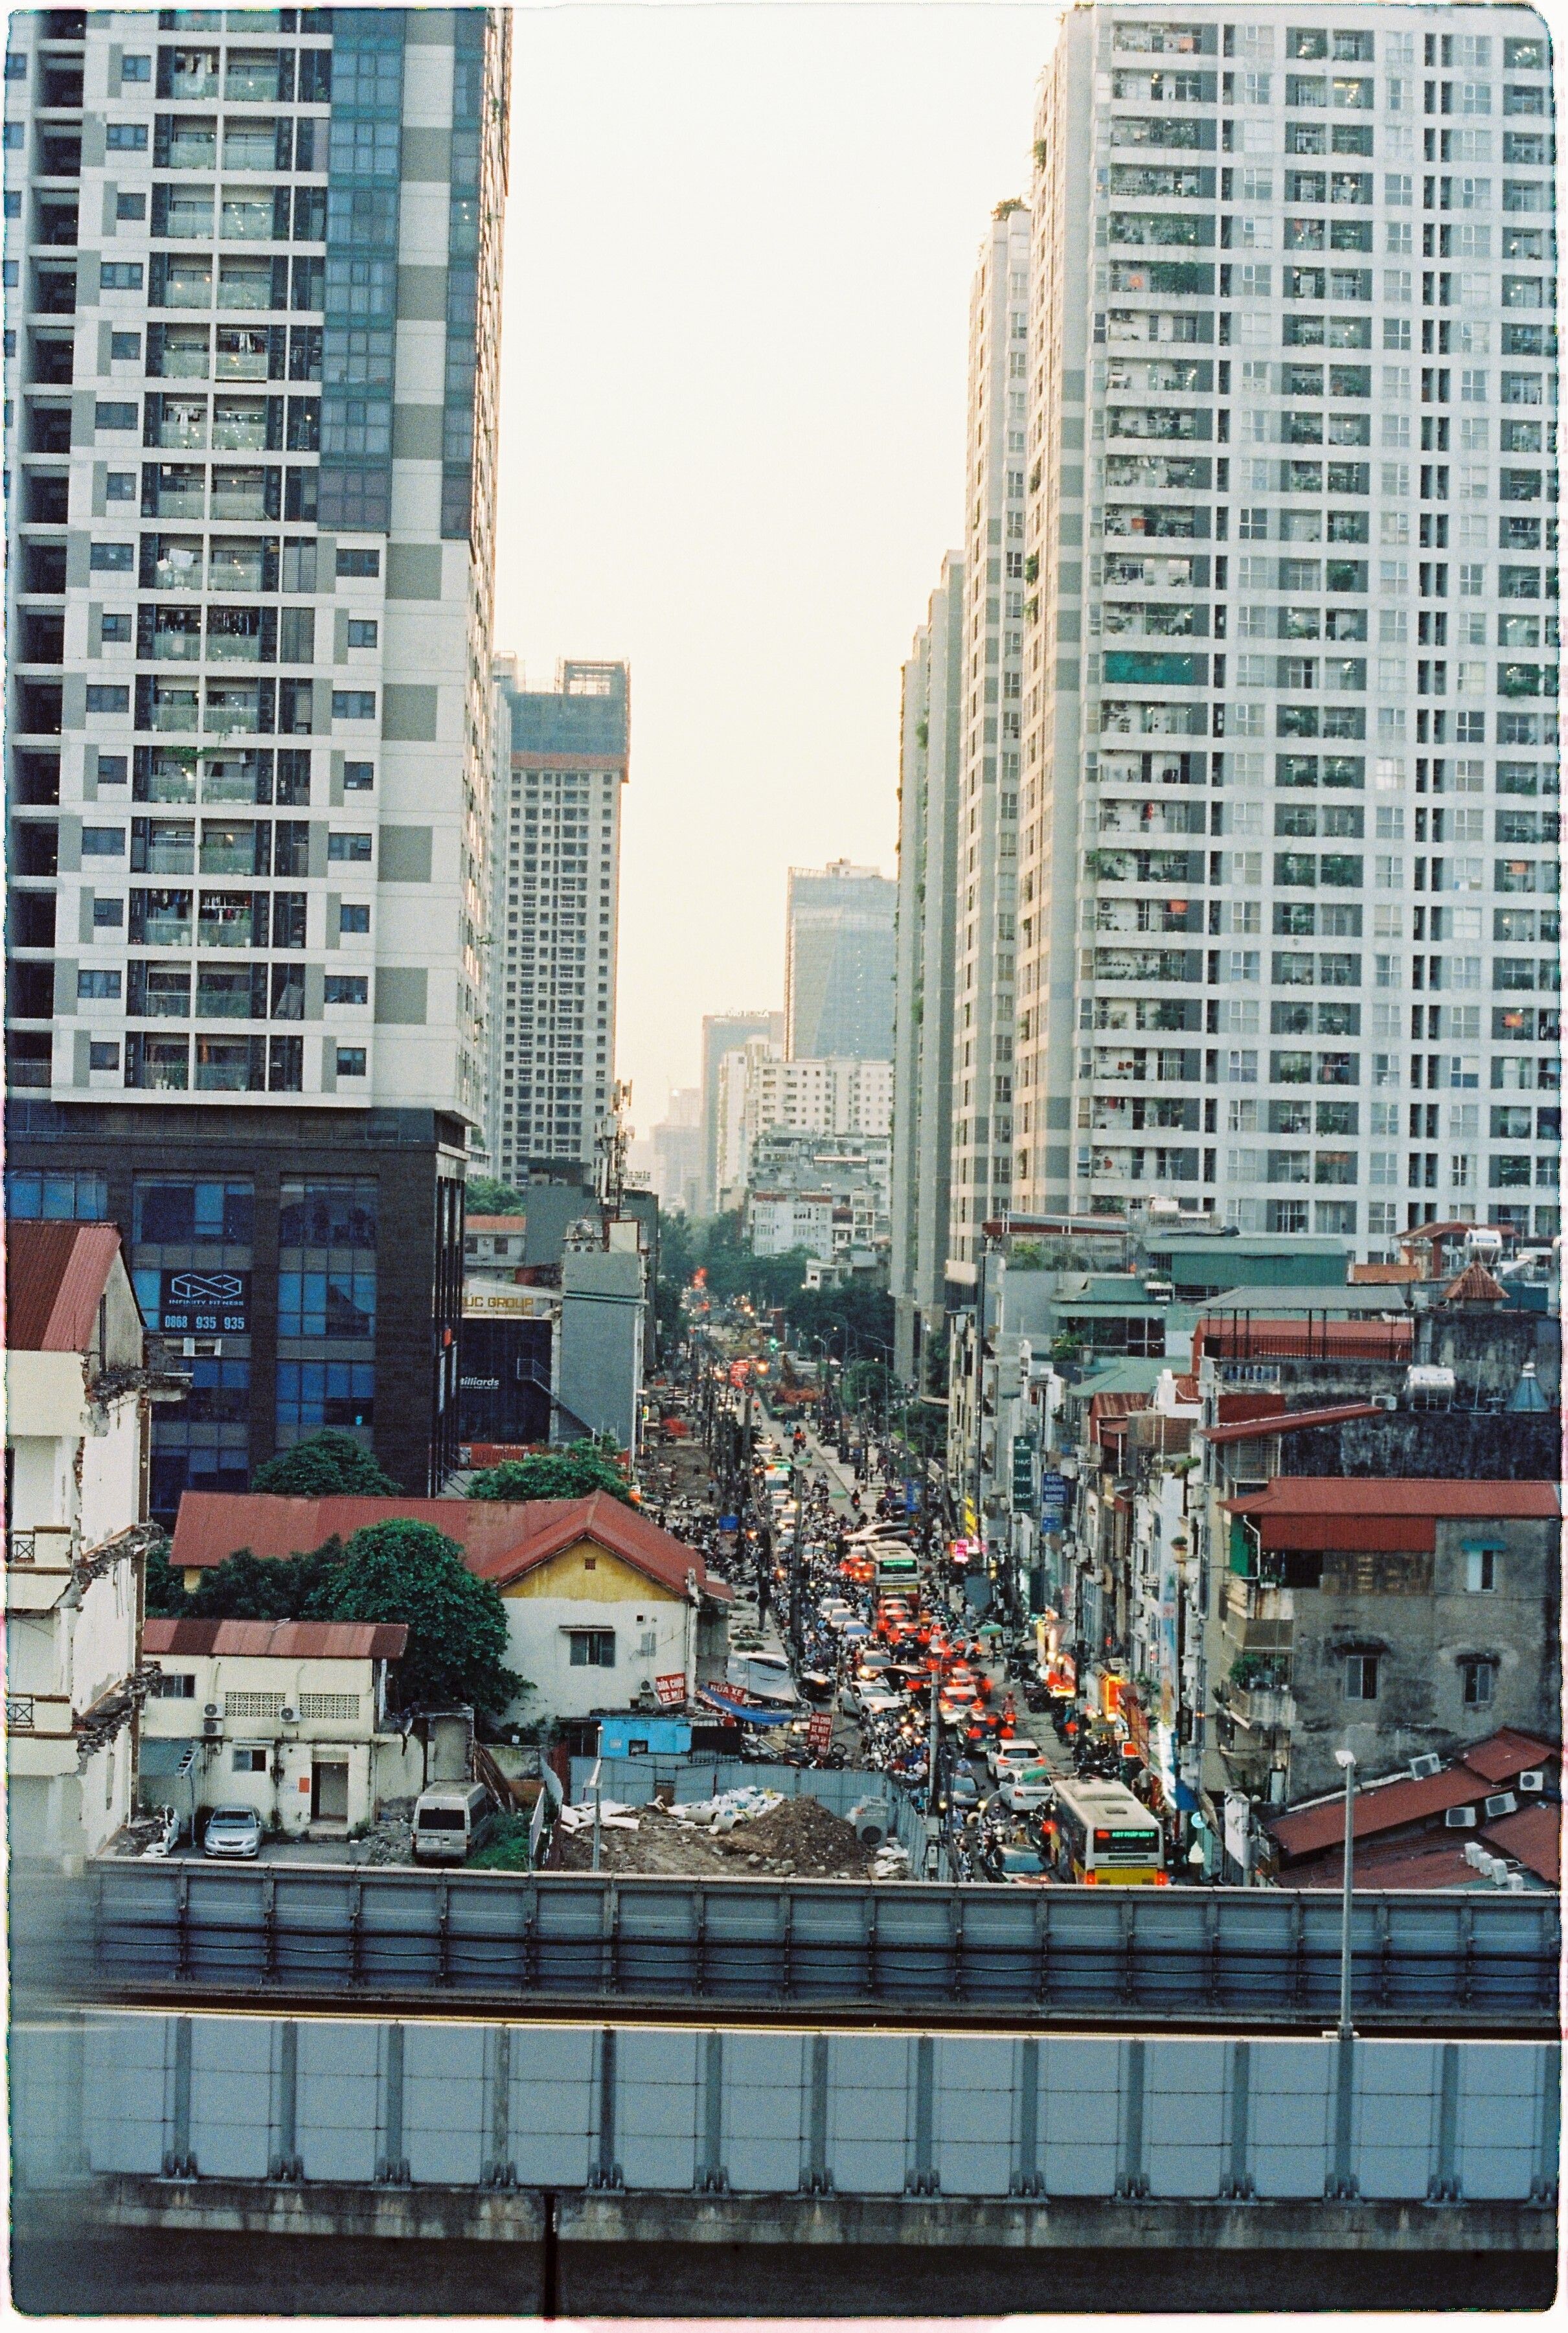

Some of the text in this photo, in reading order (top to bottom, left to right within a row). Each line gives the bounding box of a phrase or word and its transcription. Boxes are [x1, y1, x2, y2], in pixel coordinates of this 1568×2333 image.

[488, 1297, 534, 1308] GROUP
[196, 1316, 216, 1329] 935
[223, 1317, 245, 1330] 935
[732, 1688, 743, 1696] XE
